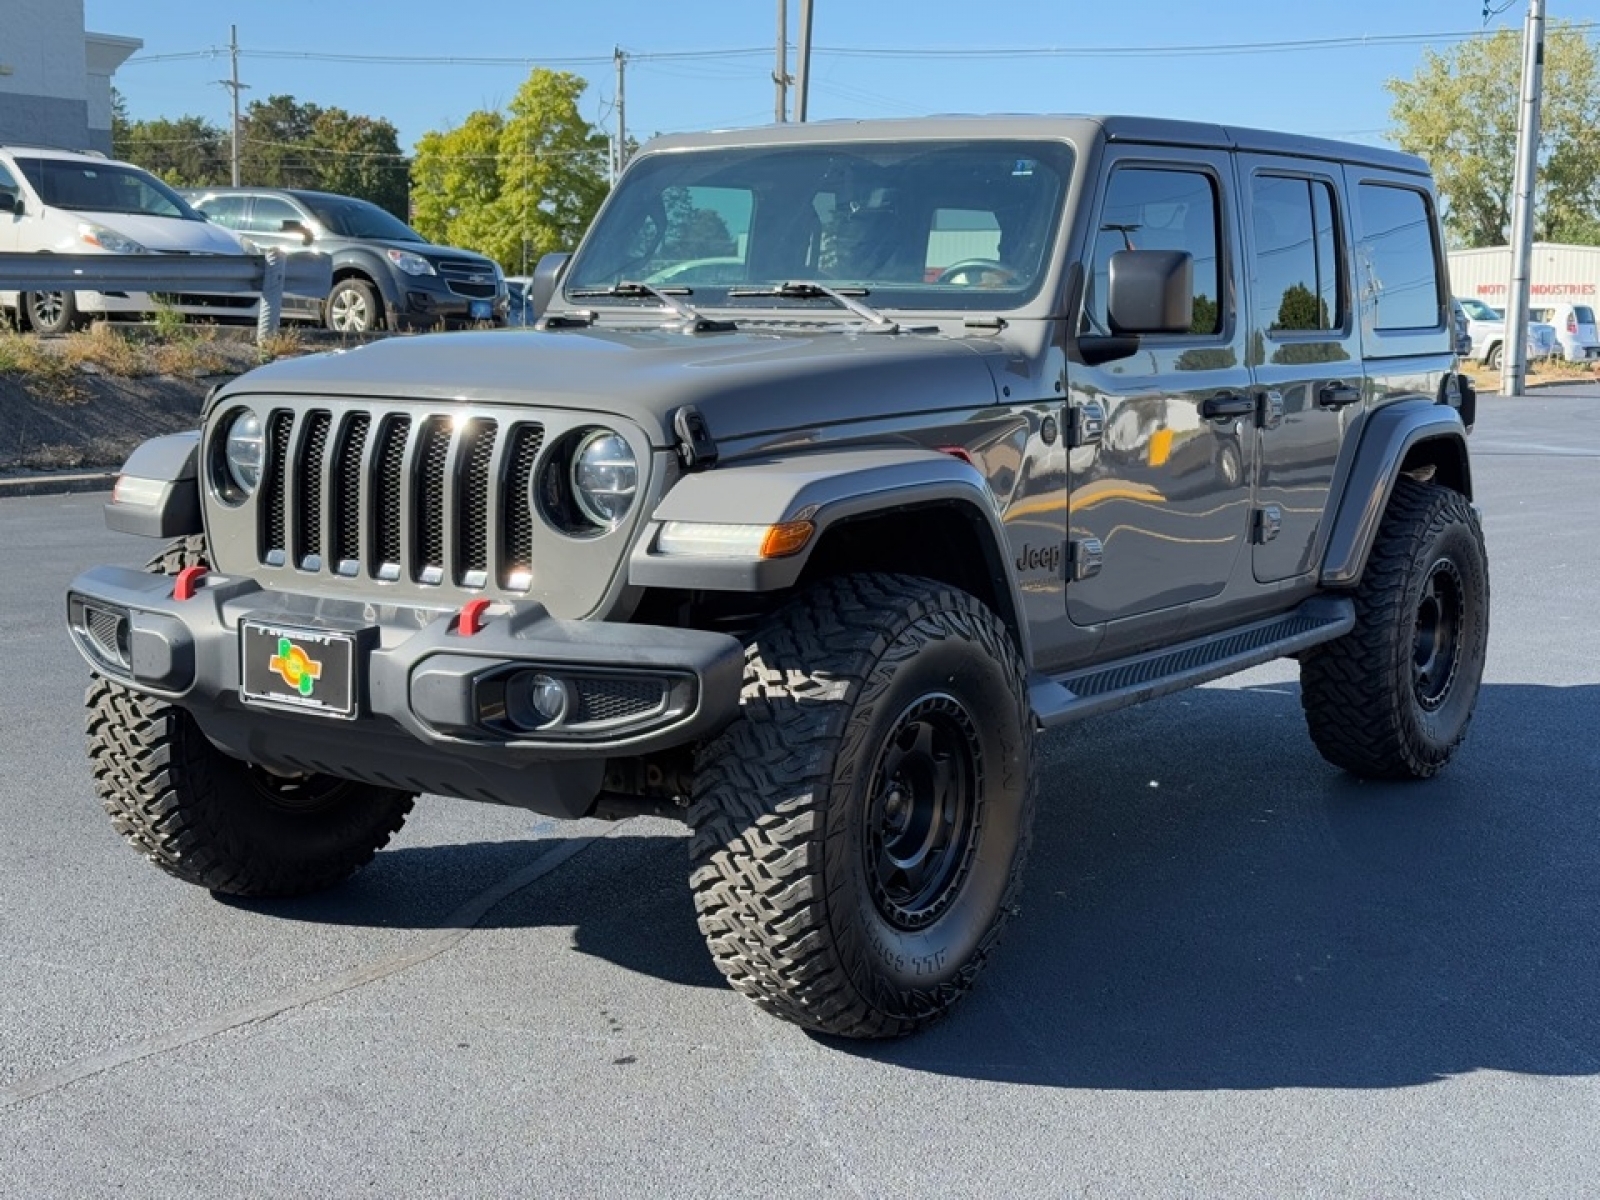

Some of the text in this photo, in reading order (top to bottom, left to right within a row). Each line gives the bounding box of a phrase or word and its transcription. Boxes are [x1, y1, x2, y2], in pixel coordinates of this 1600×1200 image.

[1476, 284, 1596, 295] MOTI NDUSTRIES
[1016, 543, 1060, 572] Jeep
